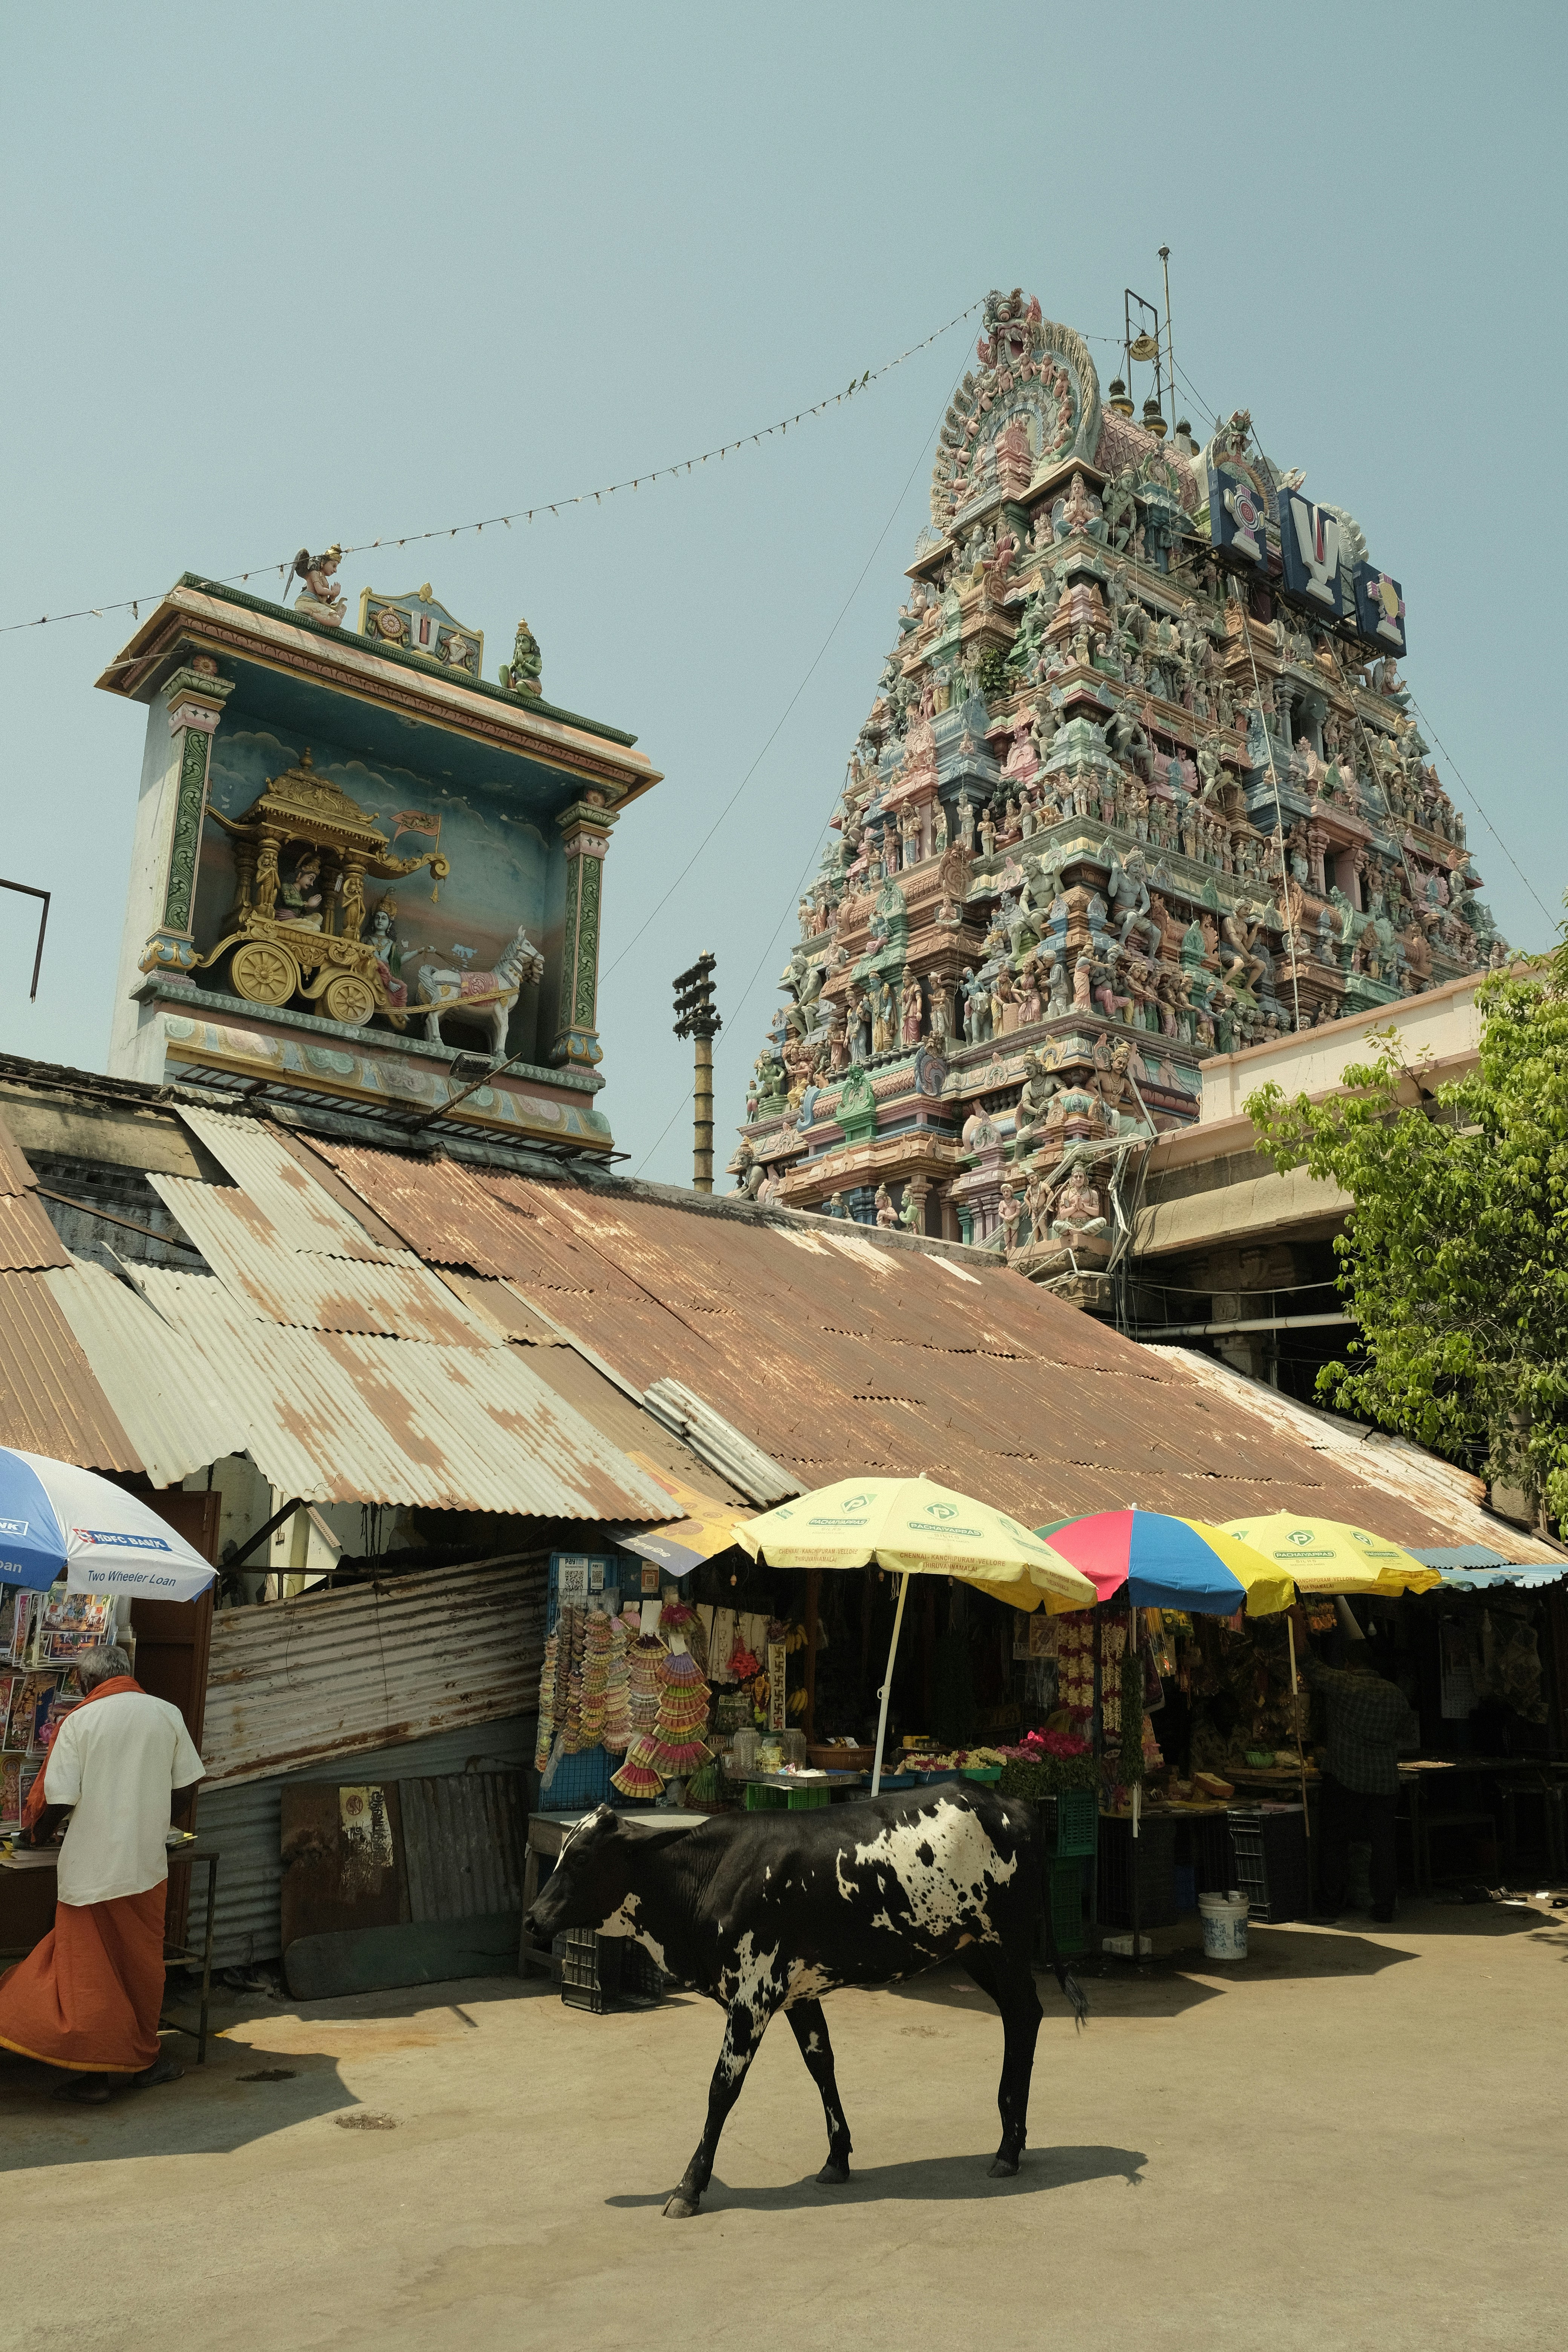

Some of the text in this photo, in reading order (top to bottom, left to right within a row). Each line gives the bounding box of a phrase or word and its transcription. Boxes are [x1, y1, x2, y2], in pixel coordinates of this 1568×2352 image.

[911, 1523, 980, 1535] PACHAIYAPPAS
[93, 1534, 166, 1548] HDFC BANK
[931, 1554, 975, 1563] KANCHIPURAM
[923, 1562, 977, 1572] THIRUVANNAMALAI
[88, 1570, 176, 1586] Two Wheeler Loan
[1070, 1580, 1084, 1589] VELLORE
